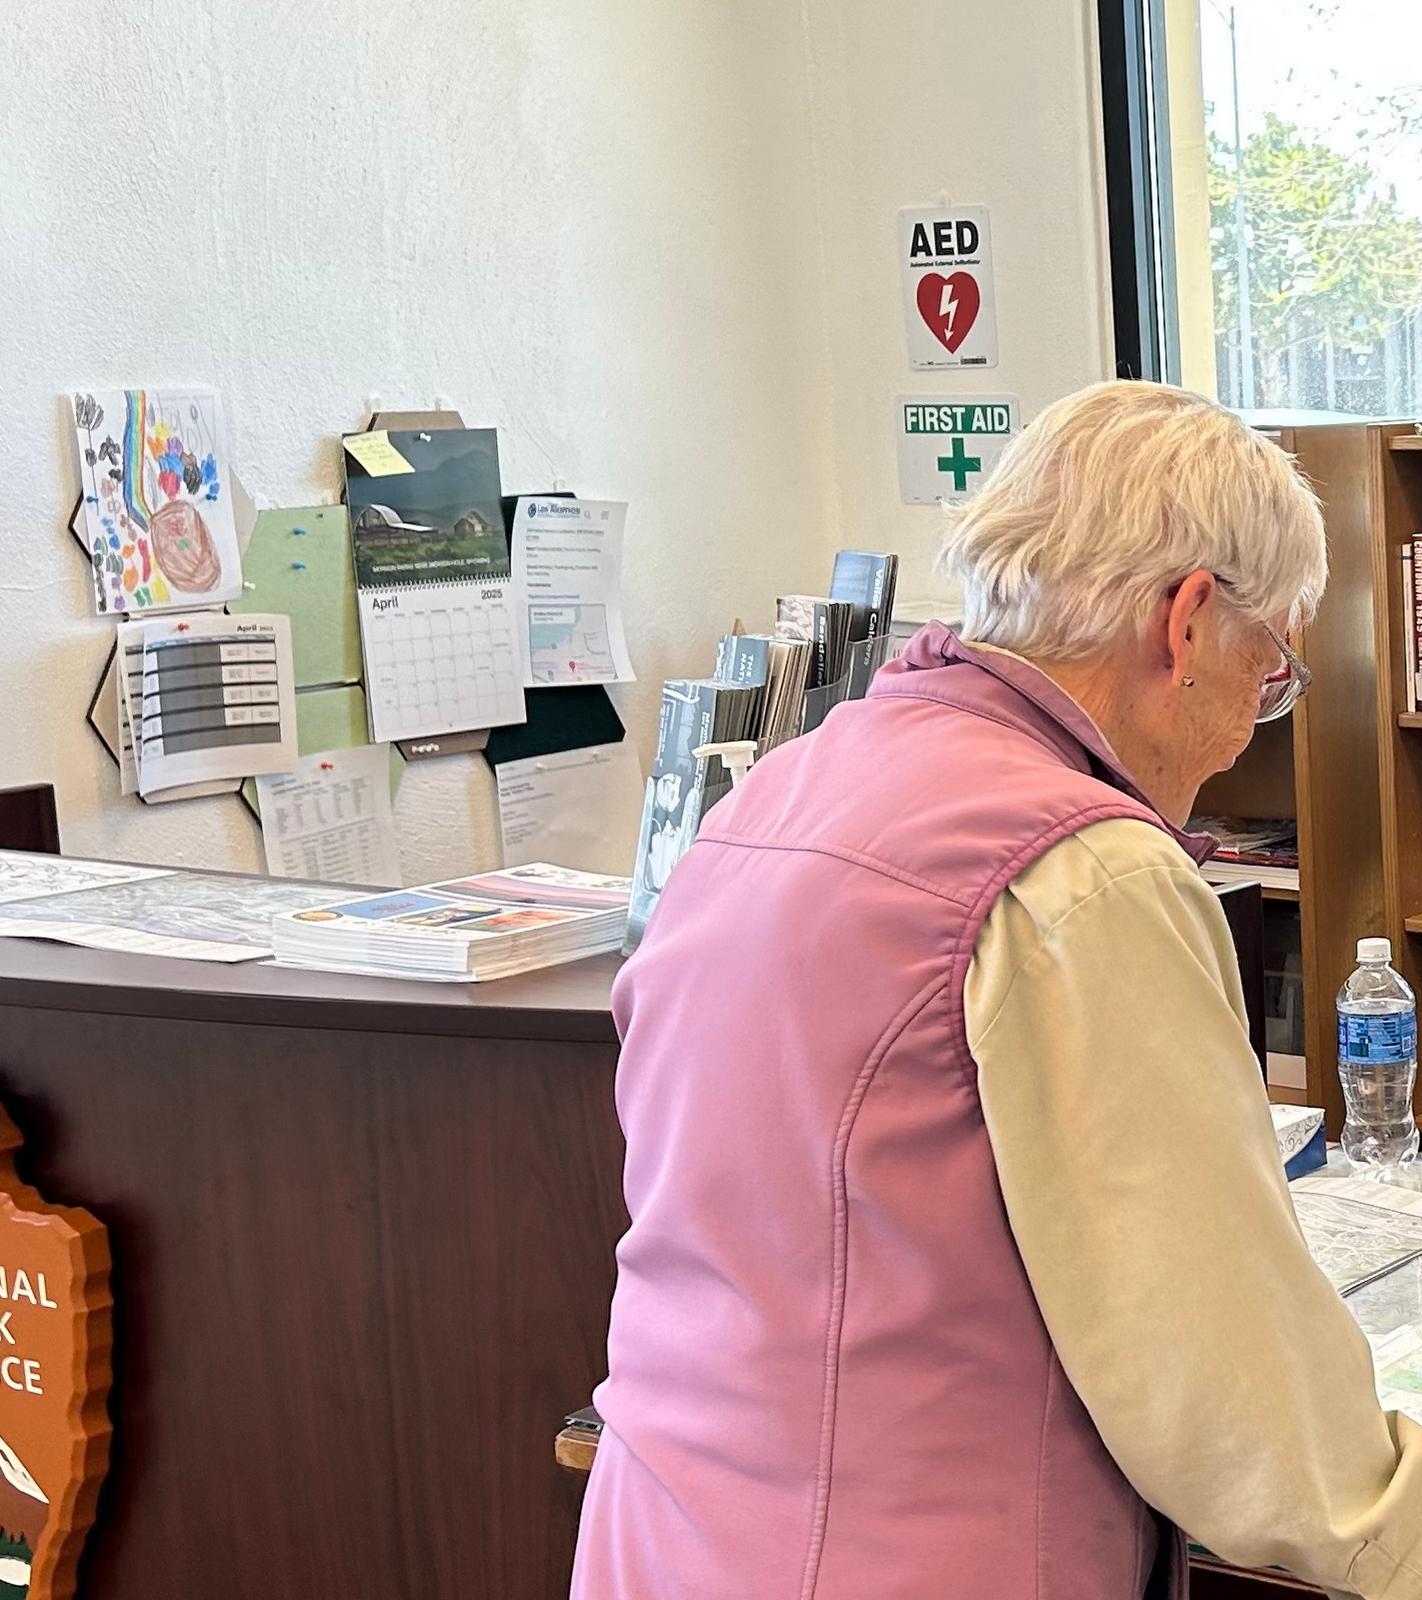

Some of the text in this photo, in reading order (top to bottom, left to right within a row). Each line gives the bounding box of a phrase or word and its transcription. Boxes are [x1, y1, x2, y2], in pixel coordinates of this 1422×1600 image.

[910, 220, 979, 257] AED
[906, 406, 1009, 432] FIRST AID
[372, 588, 503, 612] April 2025
[236, 624, 258, 633] April
[862, 568, 884, 666] Valles Caldera
[815, 616, 827, 687] Bandelier
[746, 654, 754, 678] THE
